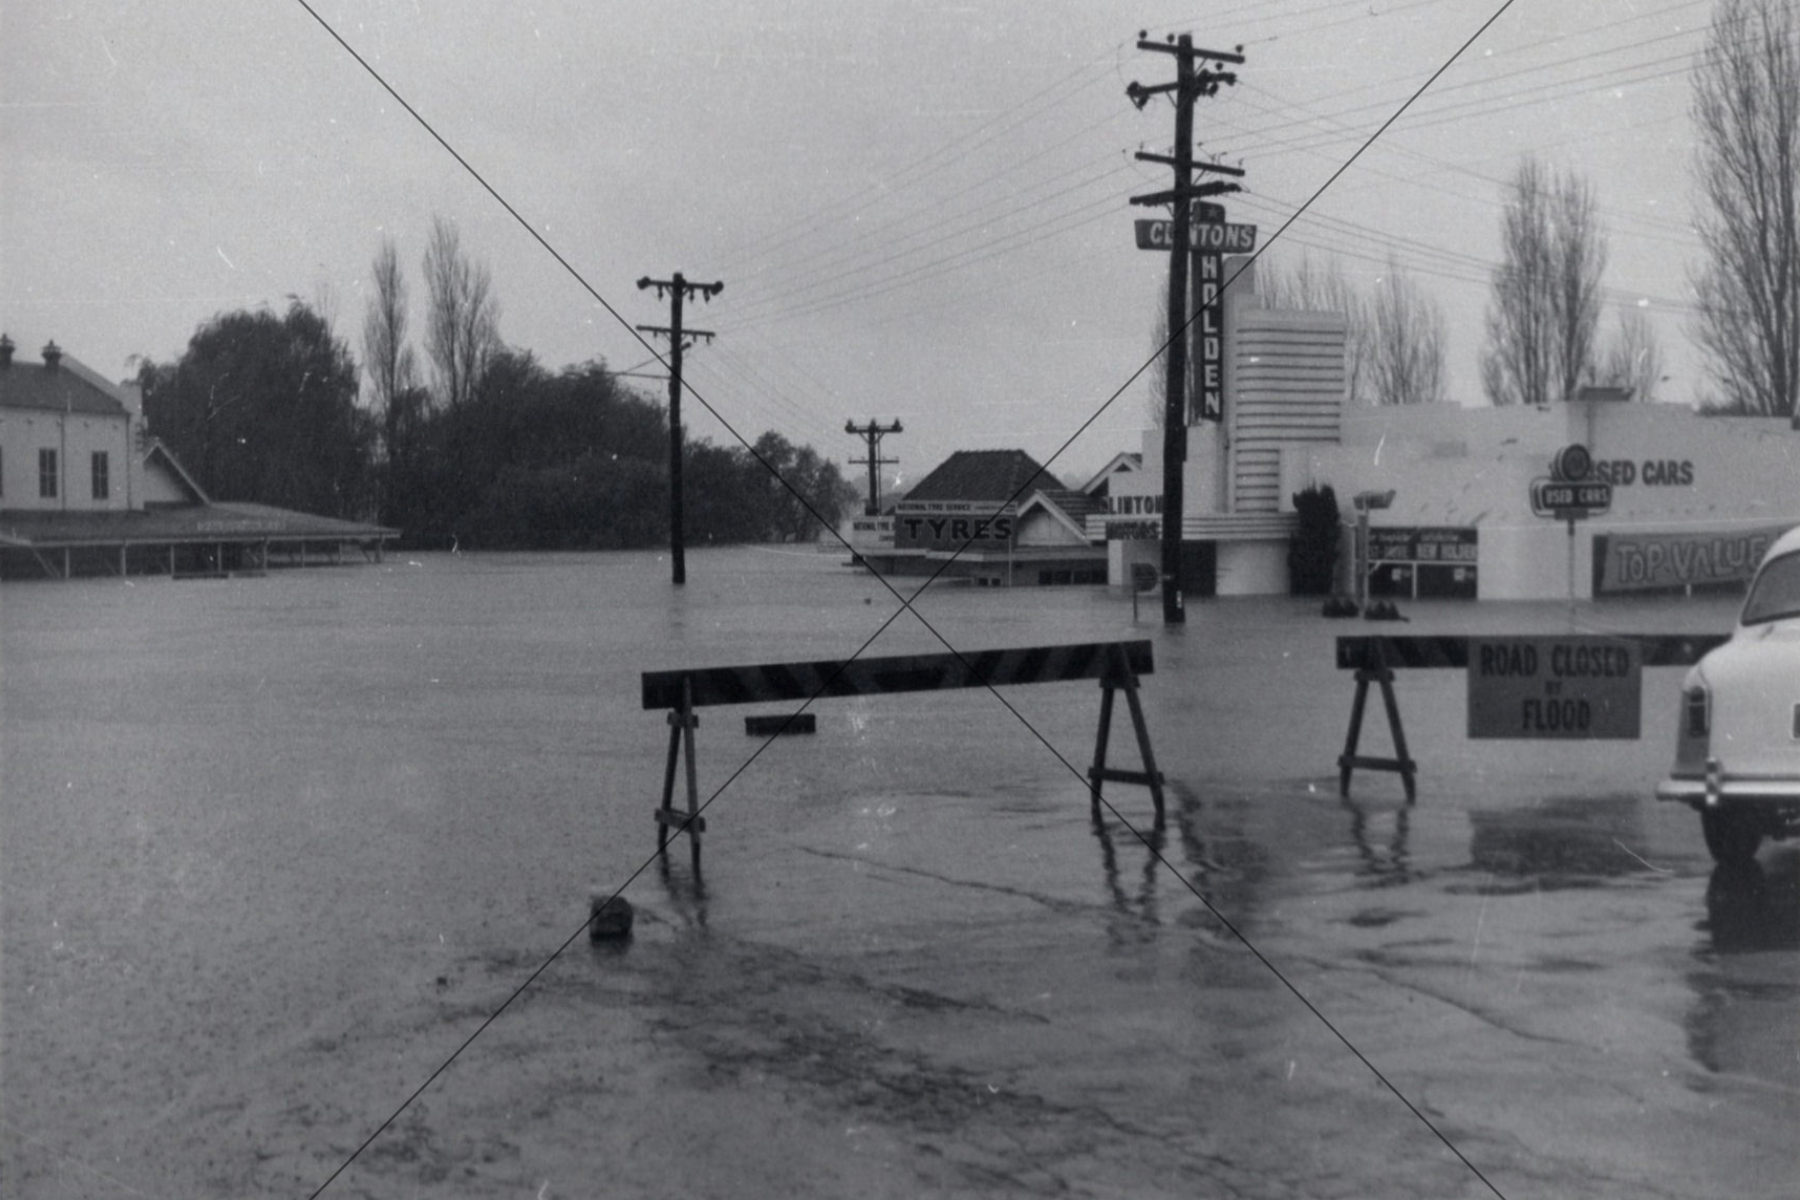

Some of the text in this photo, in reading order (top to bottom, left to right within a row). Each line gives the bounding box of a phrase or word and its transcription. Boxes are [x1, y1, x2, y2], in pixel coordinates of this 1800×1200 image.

[1150, 221, 1254, 248] CLNTONS
[1202, 255, 1221, 415] HOLDEN
[1642, 460, 1694, 486] CARS
[904, 518, 1012, 540] TYRES
[1480, 644, 1630, 678] ROAD CLOSED
[1522, 699, 1591, 731] FLOOD
